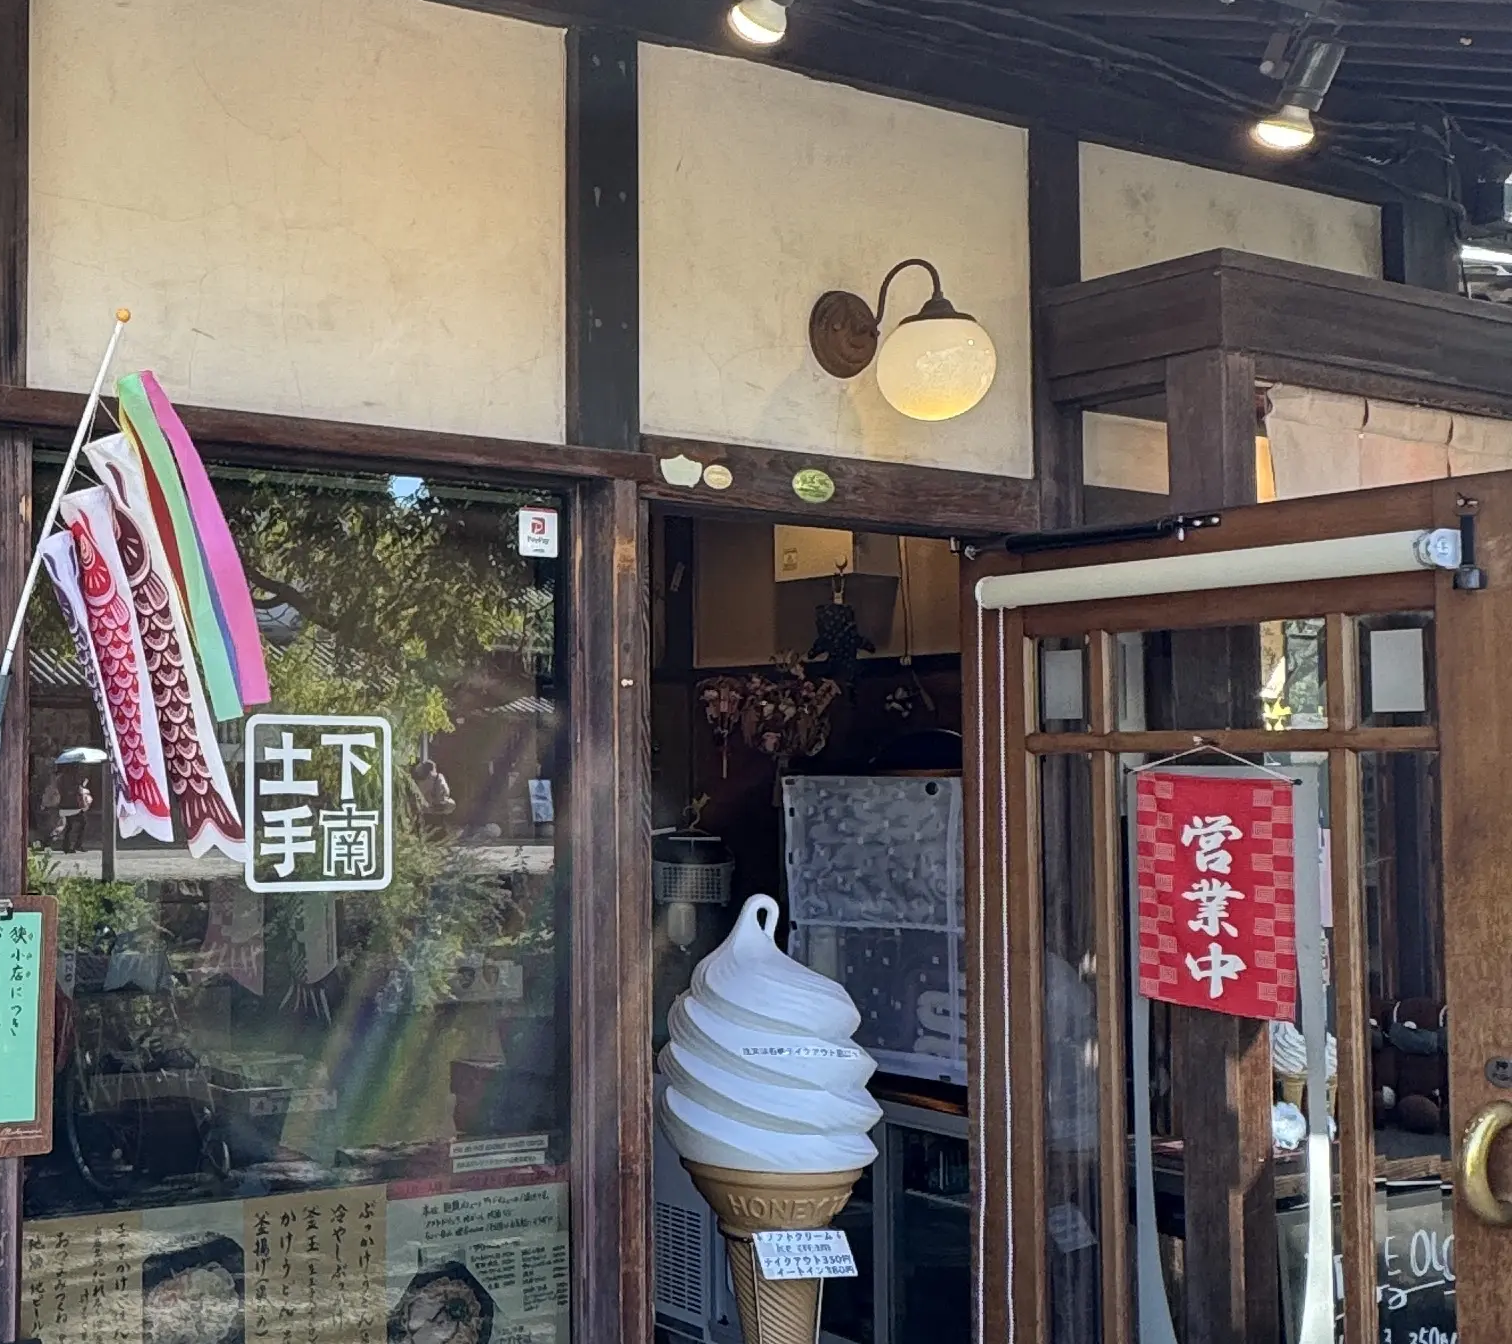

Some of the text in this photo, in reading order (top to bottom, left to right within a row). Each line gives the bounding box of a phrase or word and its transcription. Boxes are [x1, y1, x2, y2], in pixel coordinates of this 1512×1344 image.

[1180, 814, 1246, 1001] 営業中
[727, 1193, 830, 1220] HONEY
